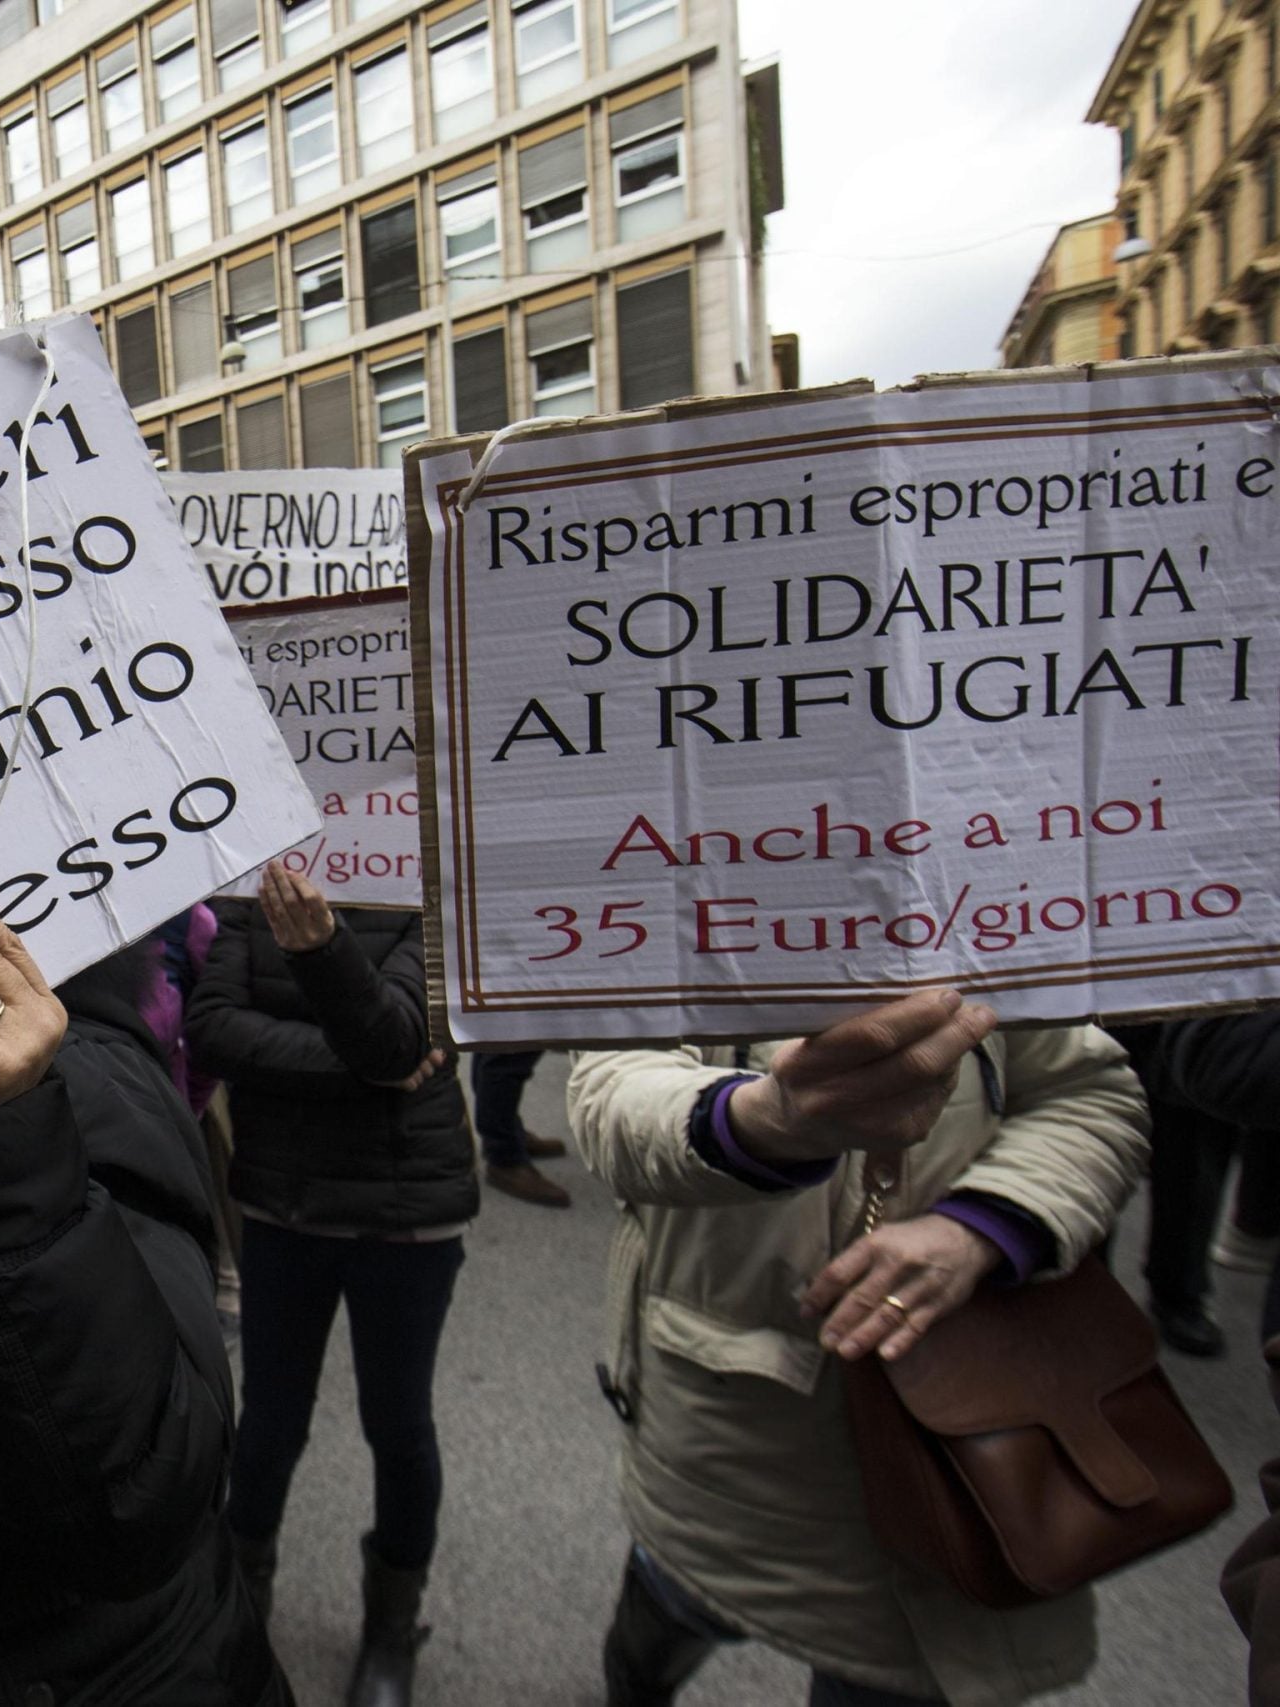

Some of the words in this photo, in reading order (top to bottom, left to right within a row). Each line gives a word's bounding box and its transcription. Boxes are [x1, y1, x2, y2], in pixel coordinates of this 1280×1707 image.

[168, 491, 340, 549] OVERNO
[487, 473, 816, 573] Risparmi
[849, 442, 1207, 538] espropriati
[1236, 457, 1276, 499] e
[566, 545, 1210, 667] SOLIDARIETA'
[490, 691, 607, 762] AI
[655, 637, 1253, 750] RIFUGIATI
[323, 791, 349, 816] a
[599, 803, 932, 871] Anche
[963, 812, 1010, 850] a
[1037, 779, 1168, 843] noi
[283, 837, 423, 885] o/gior
[528, 900, 648, 962] 35
[691, 883, 1243, 955] Euro/giorno
